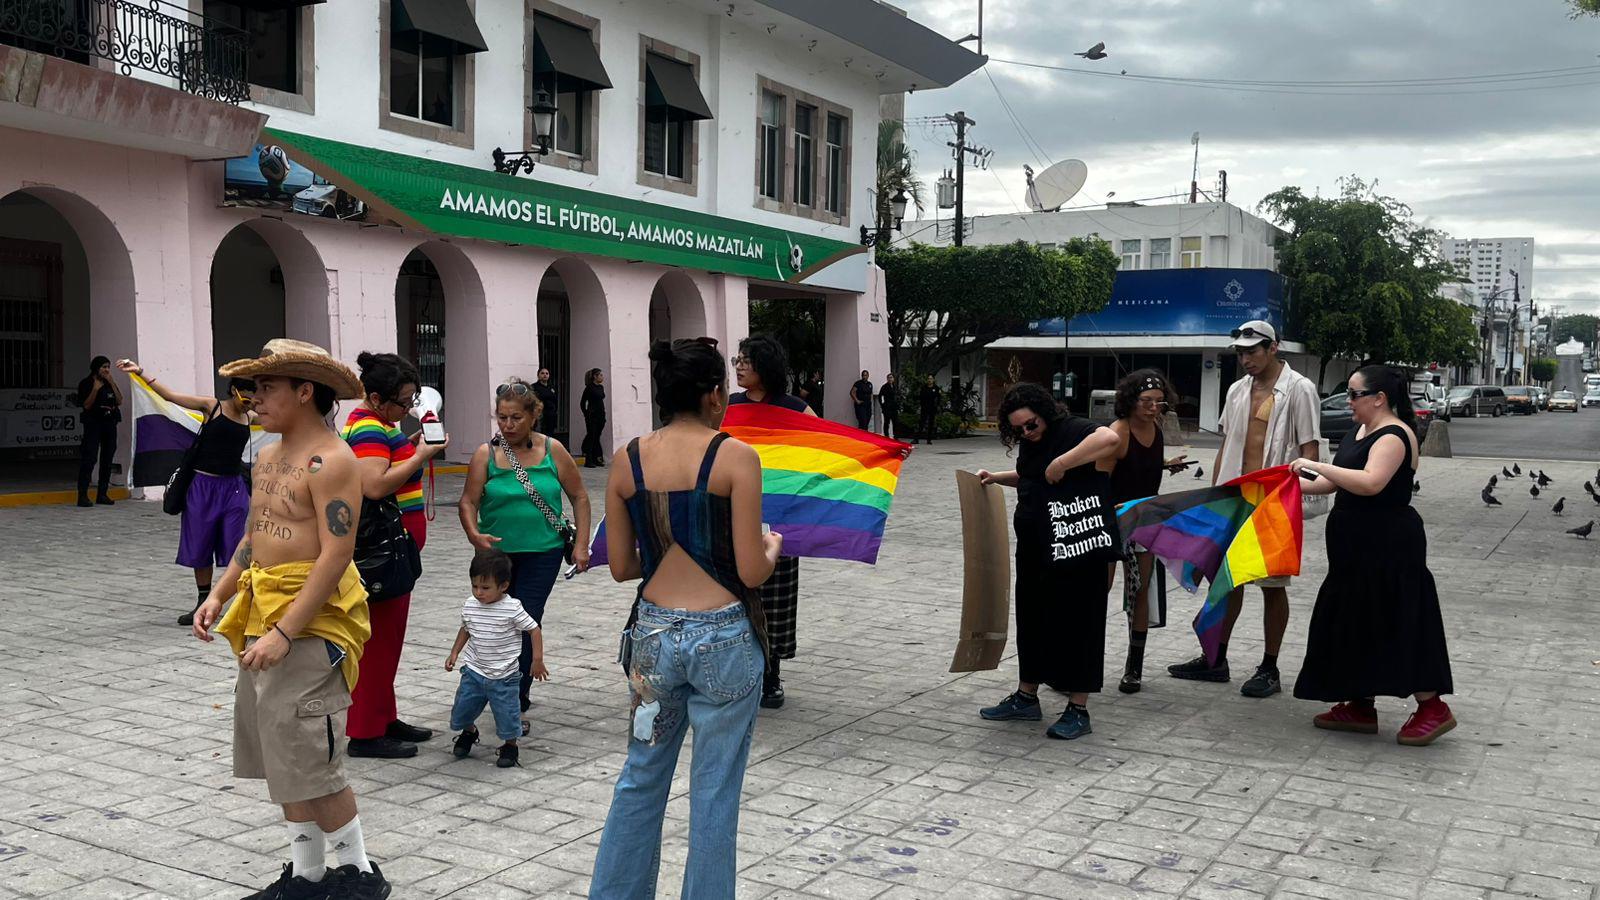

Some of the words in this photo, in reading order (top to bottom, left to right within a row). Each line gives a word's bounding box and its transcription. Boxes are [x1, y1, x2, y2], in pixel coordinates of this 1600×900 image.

[439, 188, 532, 223] AMAMOS
[536, 207, 556, 227] EL
[559, 204, 625, 242] FÚTBOL,
[627, 221, 694, 249] AMAMOS
[696, 232, 763, 260] MAZATLÁN
[42, 417, 74, 430] 072
[1047, 495, 1101, 521] Broken
[1051, 514, 1104, 542] Beaten
[1051, 530, 1112, 561] Damned
